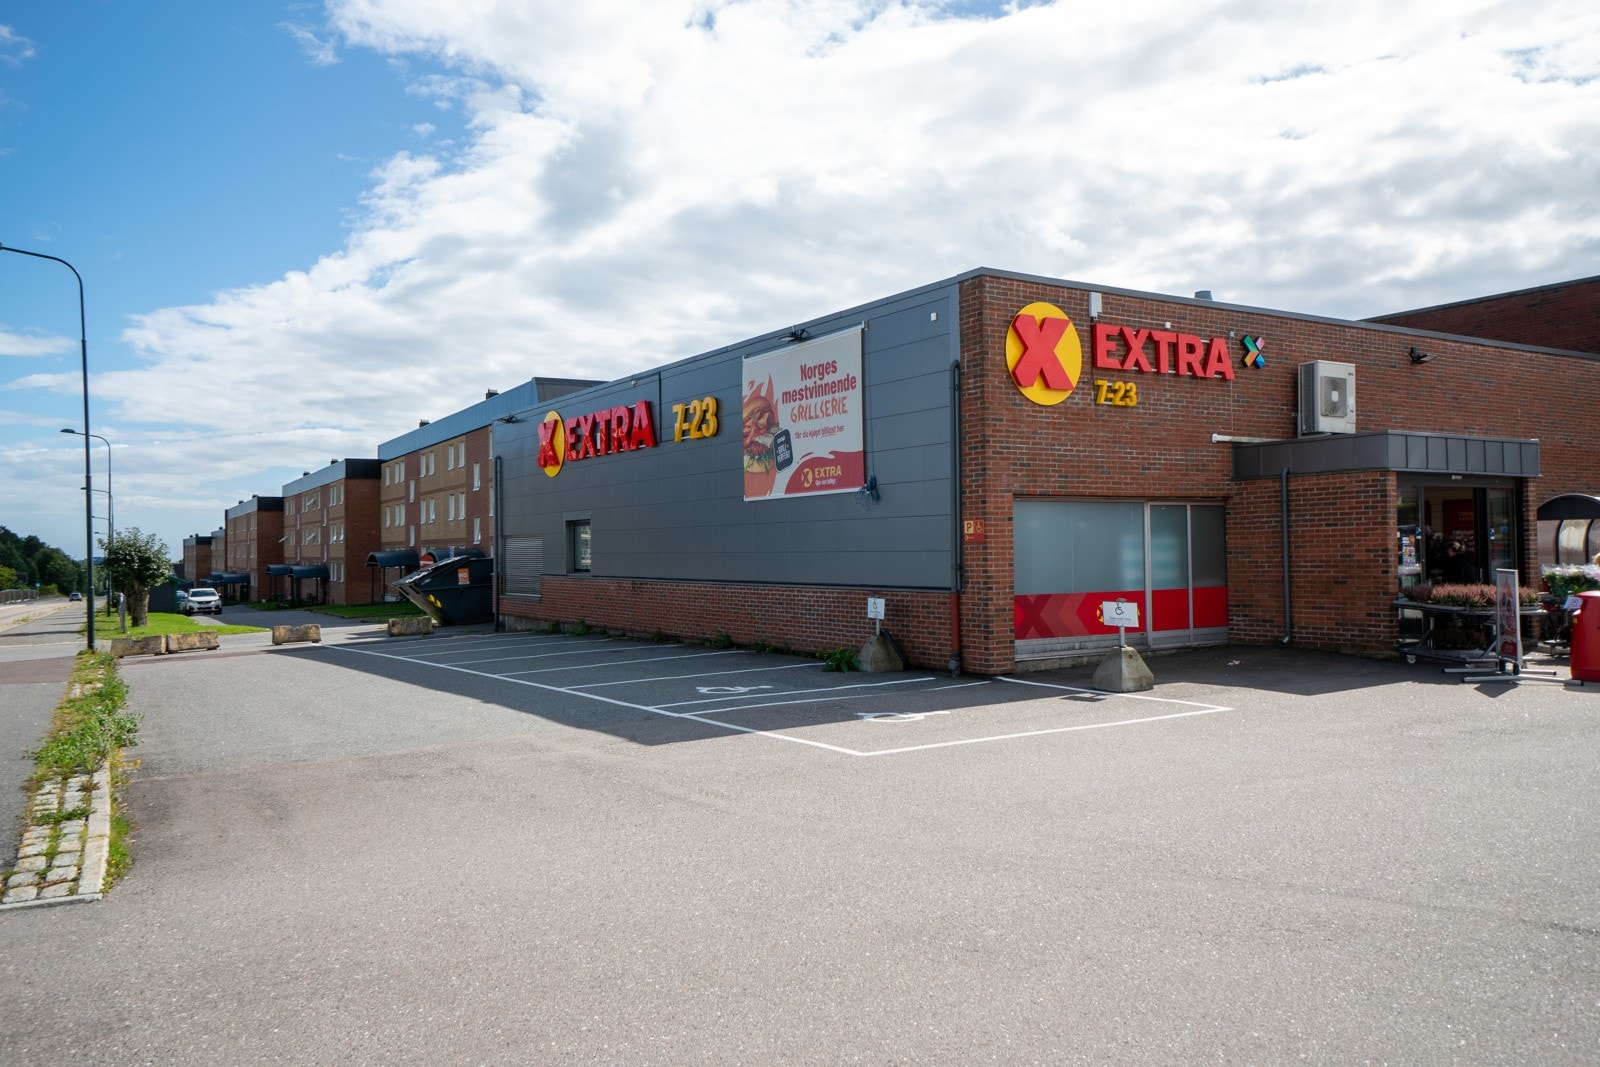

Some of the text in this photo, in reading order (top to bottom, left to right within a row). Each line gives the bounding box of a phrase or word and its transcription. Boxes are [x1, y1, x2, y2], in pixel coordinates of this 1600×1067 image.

[1092, 323, 1235, 380] EXTRA
[800, 360, 837, 381] Norges
[782, 373, 857, 404] mestvinnende
[1094, 379, 1137, 407] 7-23
[790, 396, 848, 423] GRILLSERIE
[564, 400, 657, 461] EXTRA
[672, 396, 718, 442] 7-23
[814, 465, 842, 478] EXTRA
